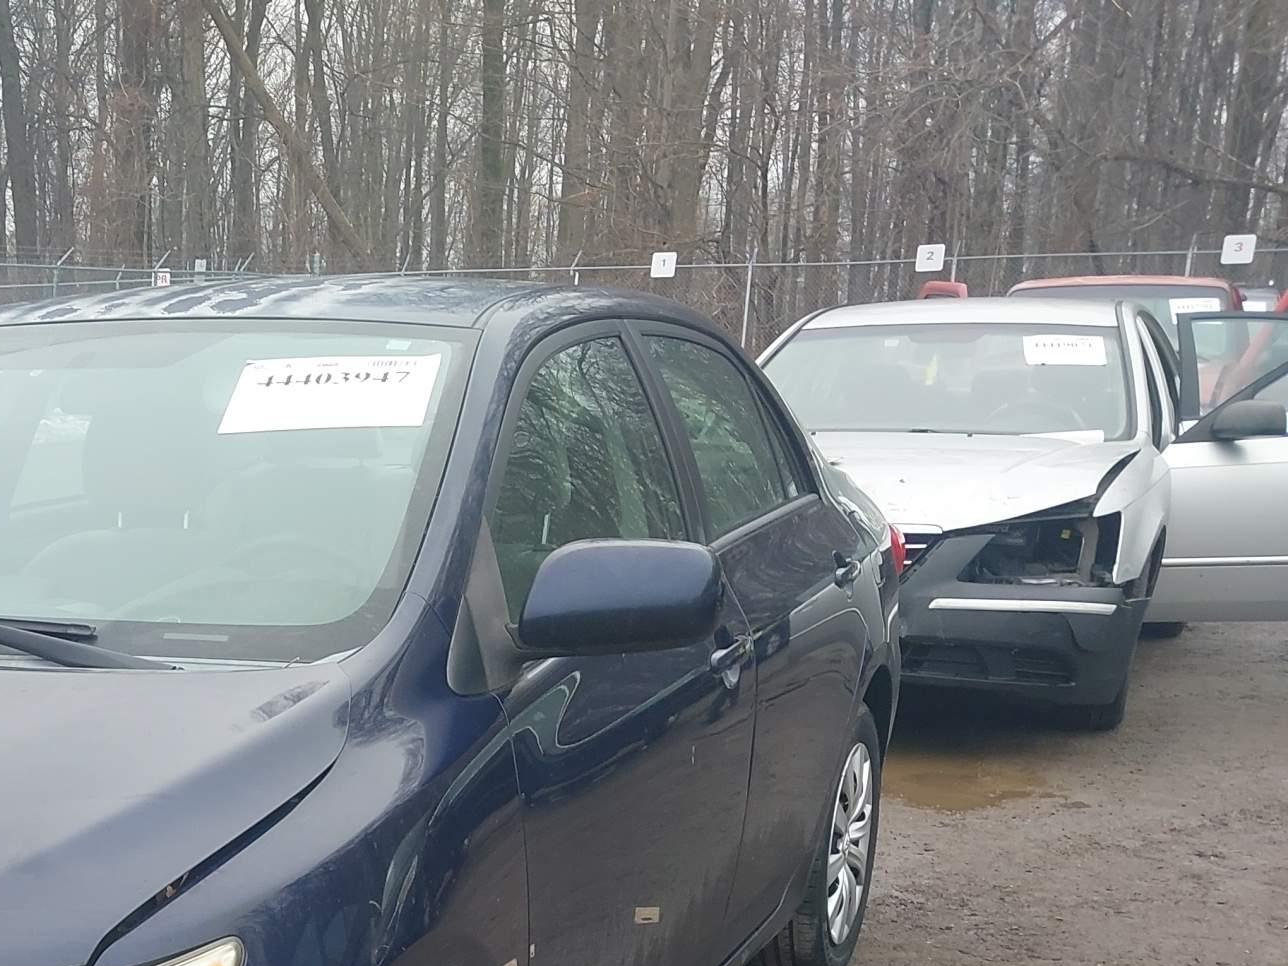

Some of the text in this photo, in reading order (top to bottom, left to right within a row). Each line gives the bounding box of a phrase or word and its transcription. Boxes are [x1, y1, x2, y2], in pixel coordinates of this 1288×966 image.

[1233, 242, 1243, 252] 3
[925, 251, 934, 260] 2
[256, 371, 410, 387] 44403947
